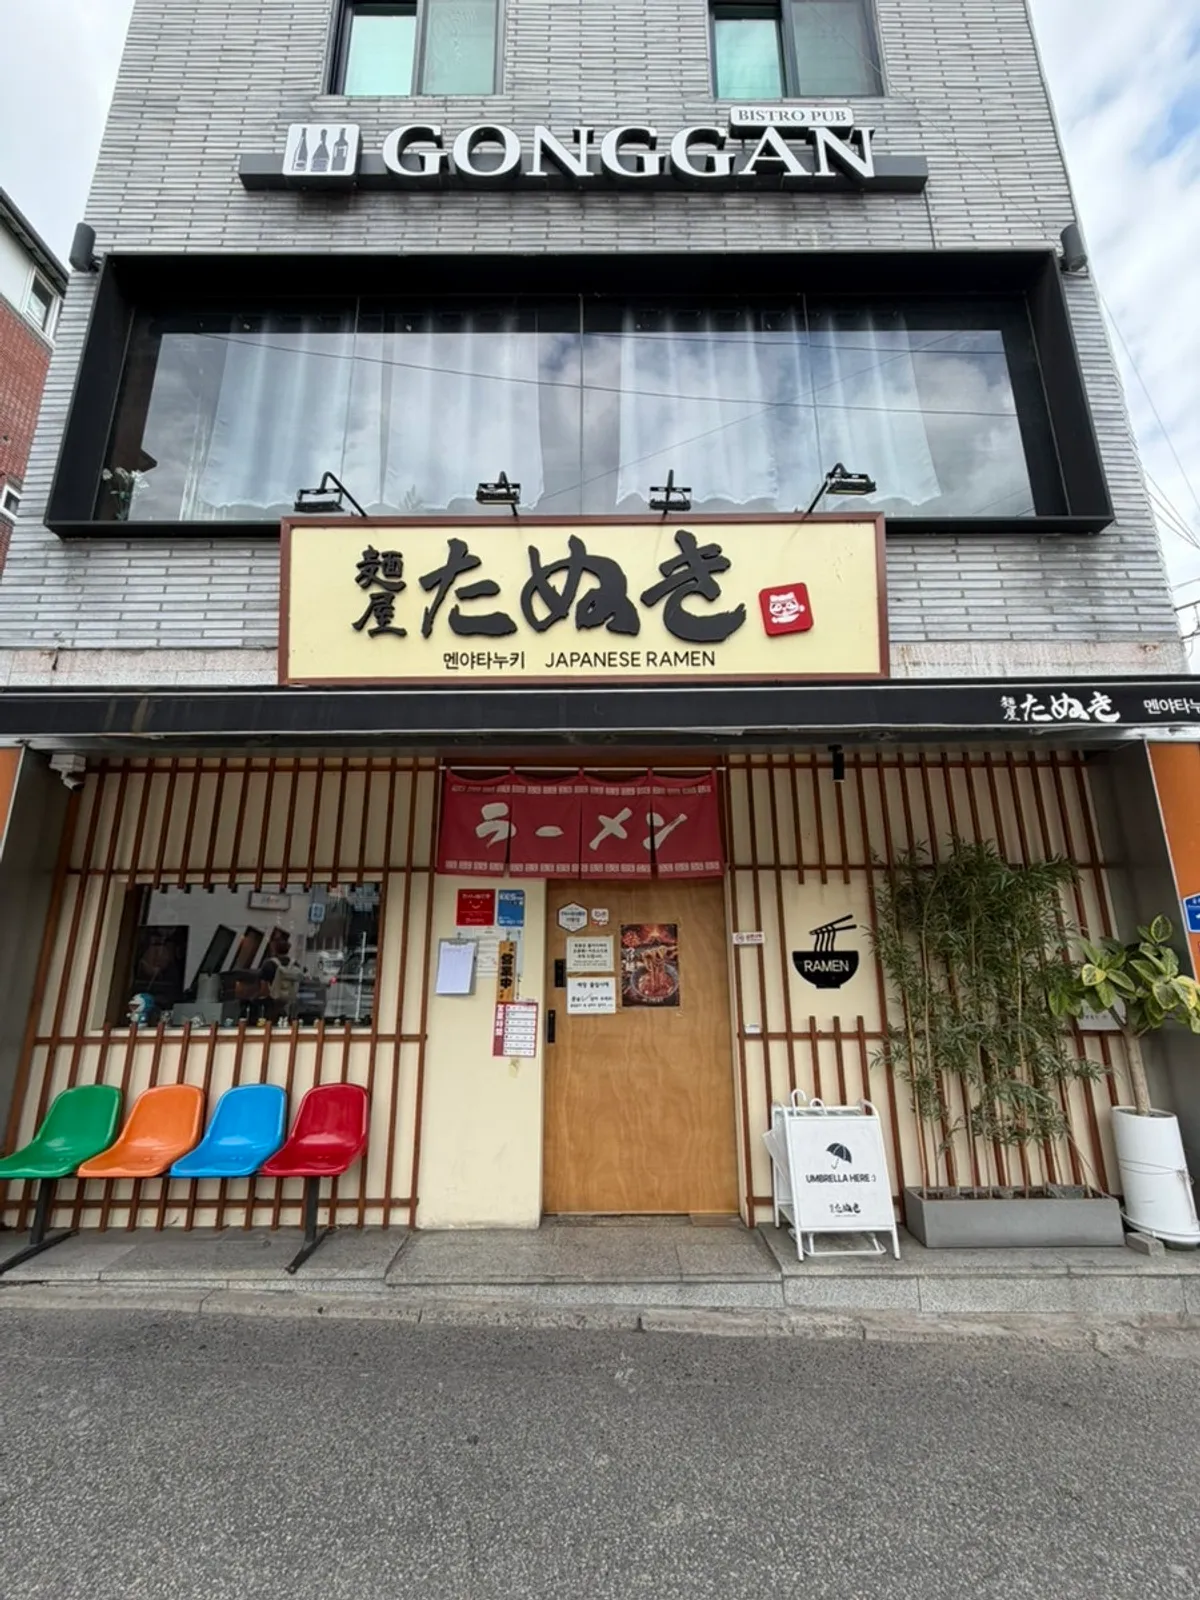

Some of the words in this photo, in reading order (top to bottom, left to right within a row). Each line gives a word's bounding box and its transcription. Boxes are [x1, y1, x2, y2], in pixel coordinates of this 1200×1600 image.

[738, 109, 805, 122] BISTRO
[811, 110, 847, 122] PUB
[381, 123, 877, 179] GONGGAN
[418, 529, 748, 644] たぬき
[442, 651, 525, 671] 멘야타누키
[544, 651, 641, 668] JAPANESE
[645, 650, 716, 668] RAMEN
[1020, 691, 1121, 723] たぬき
[475, 802, 688, 851] ラーメン
[803, 960, 850, 972] RAMEN
[805, 1173, 848, 1184] UMBRELLA
[849, 1173, 870, 1183] HERE
